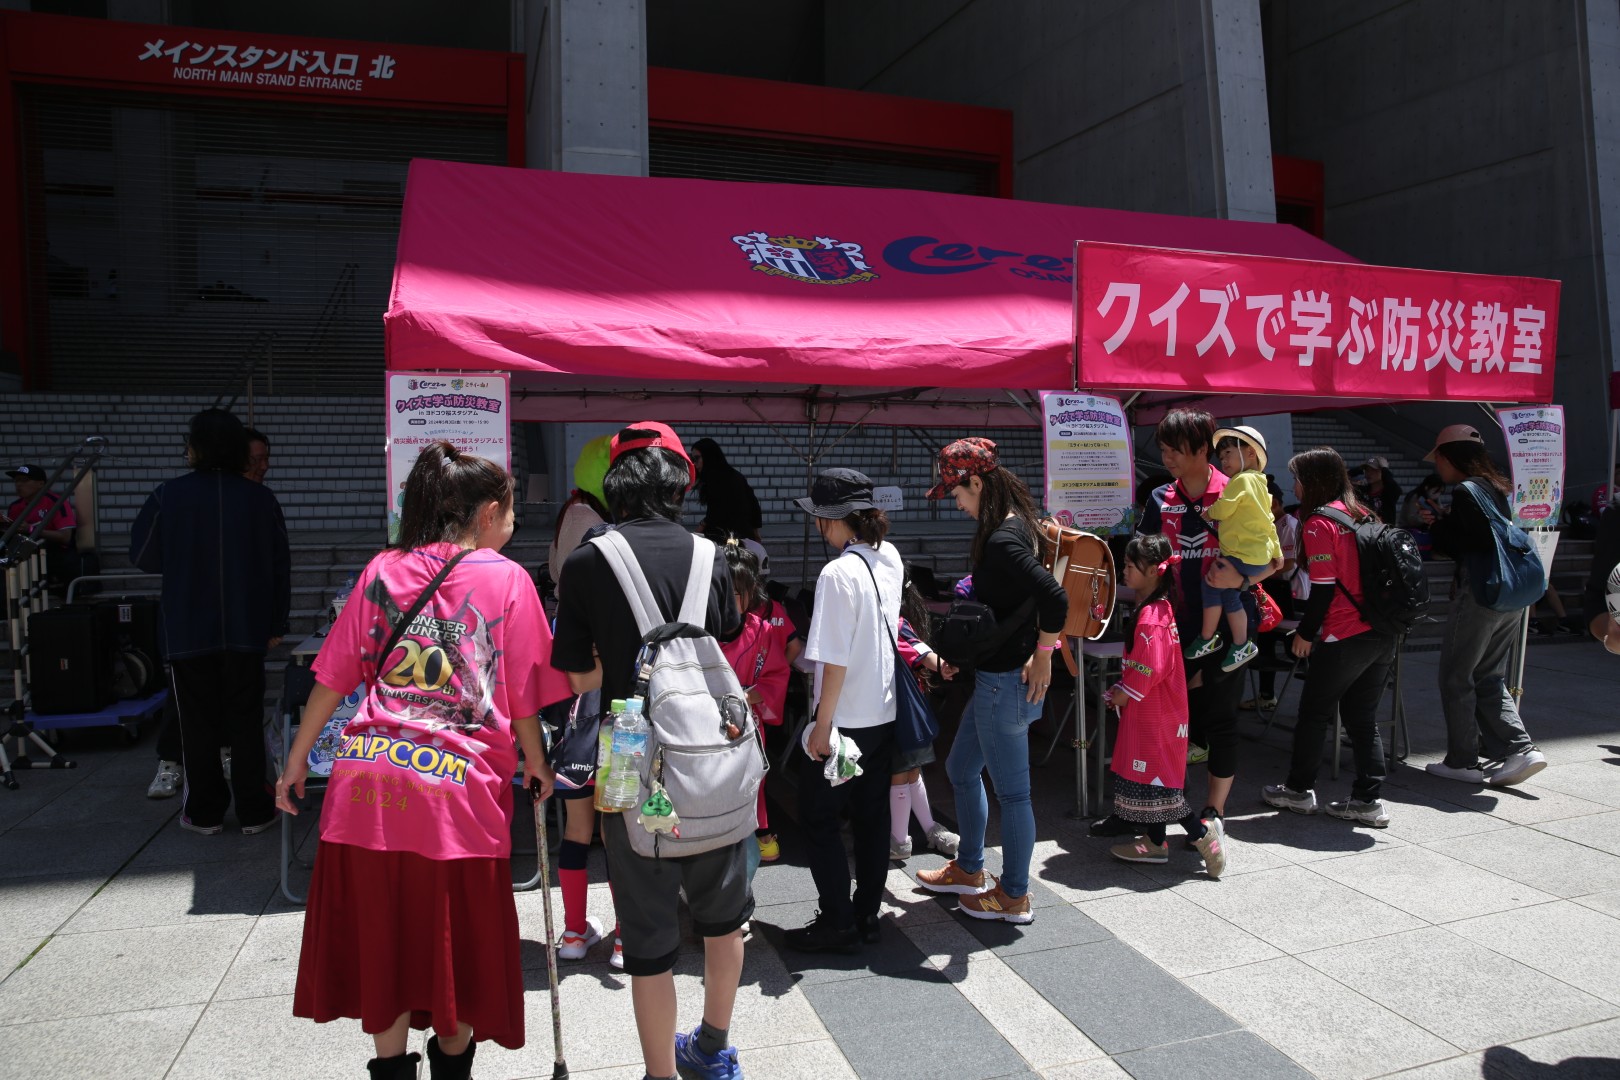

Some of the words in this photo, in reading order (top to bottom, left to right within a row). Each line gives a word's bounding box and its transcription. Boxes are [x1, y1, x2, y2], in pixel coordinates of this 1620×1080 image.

[138, 39, 359, 76] メインスタンド入口
[369, 54, 396, 79] 北
[173, 67, 216, 81] NORTH
[219, 70, 252, 84] MAIN
[256, 73, 296, 87] STAND
[299, 76, 363, 91] ENTRANCE
[882, 235, 1074, 275] Cere
[1096, 281, 1547, 374] クイズで学ぶ防災教室
[396, 394, 502, 413] クイズで学ぶ防災教室
[1173, 548, 1220, 560] ANMAR
[351, 785, 409, 811] 2024
